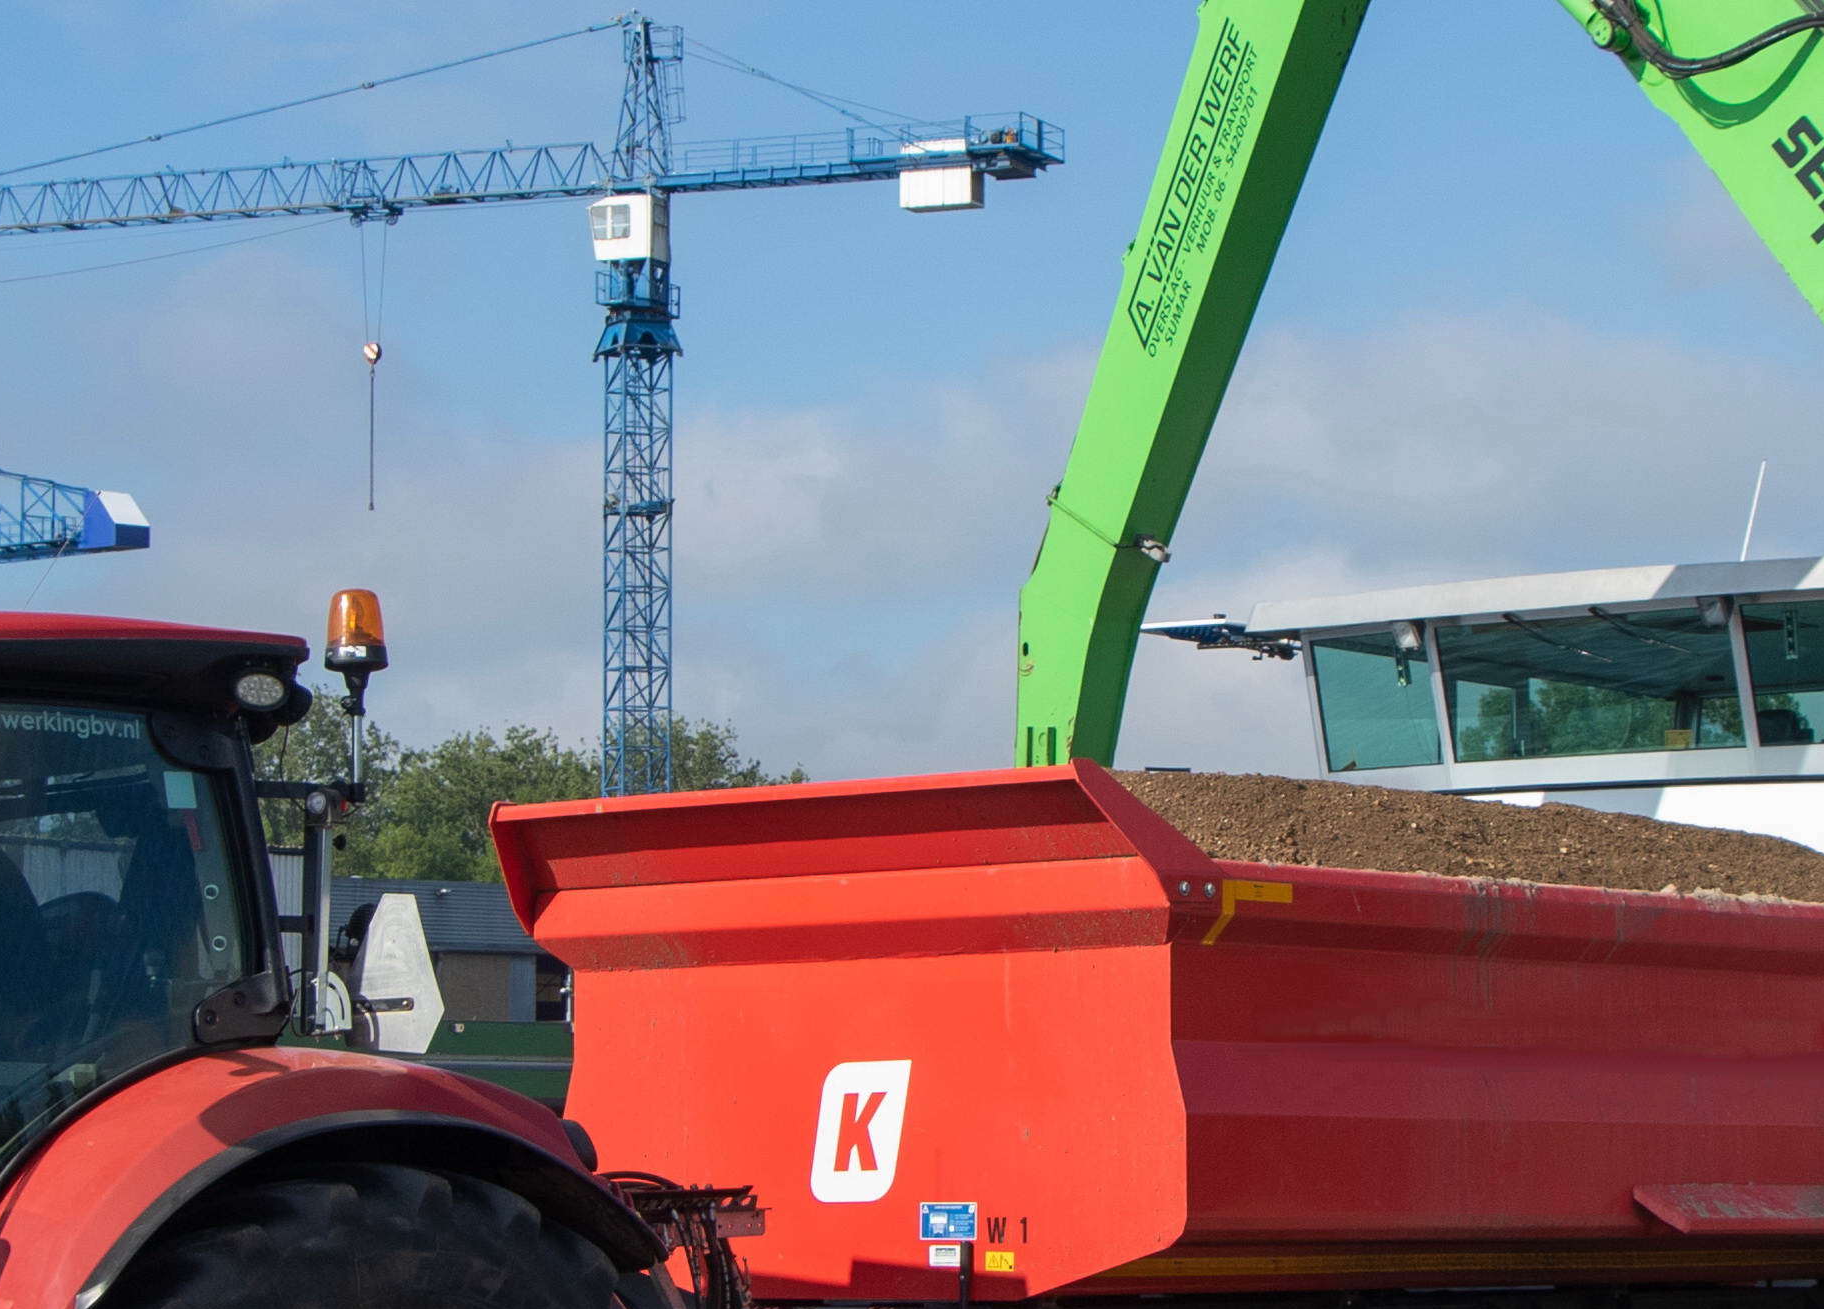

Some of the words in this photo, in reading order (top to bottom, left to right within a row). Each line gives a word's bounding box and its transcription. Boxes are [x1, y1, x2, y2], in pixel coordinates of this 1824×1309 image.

[1147, 208, 1182, 283] VAN
[1174, 132, 1209, 209] DER
[1199, 22, 1242, 129] WERF
[1147, 266, 1184, 358] OVERSLAG
[1181, 170, 1217, 254] VERHUUR
[1211, 155, 1223, 170] &
[1217, 45, 1259, 151] TRANSPORT
[1196, 208, 1219, 254] MOB.
[1212, 176, 1228, 202] 06
[1226, 85, 1258, 168] 54200701
[1164, 280, 1193, 346] SUMAR
[833, 1091, 888, 1172] K
[986, 1216, 1007, 1244] W
[1019, 1216, 1028, 1244] 1
